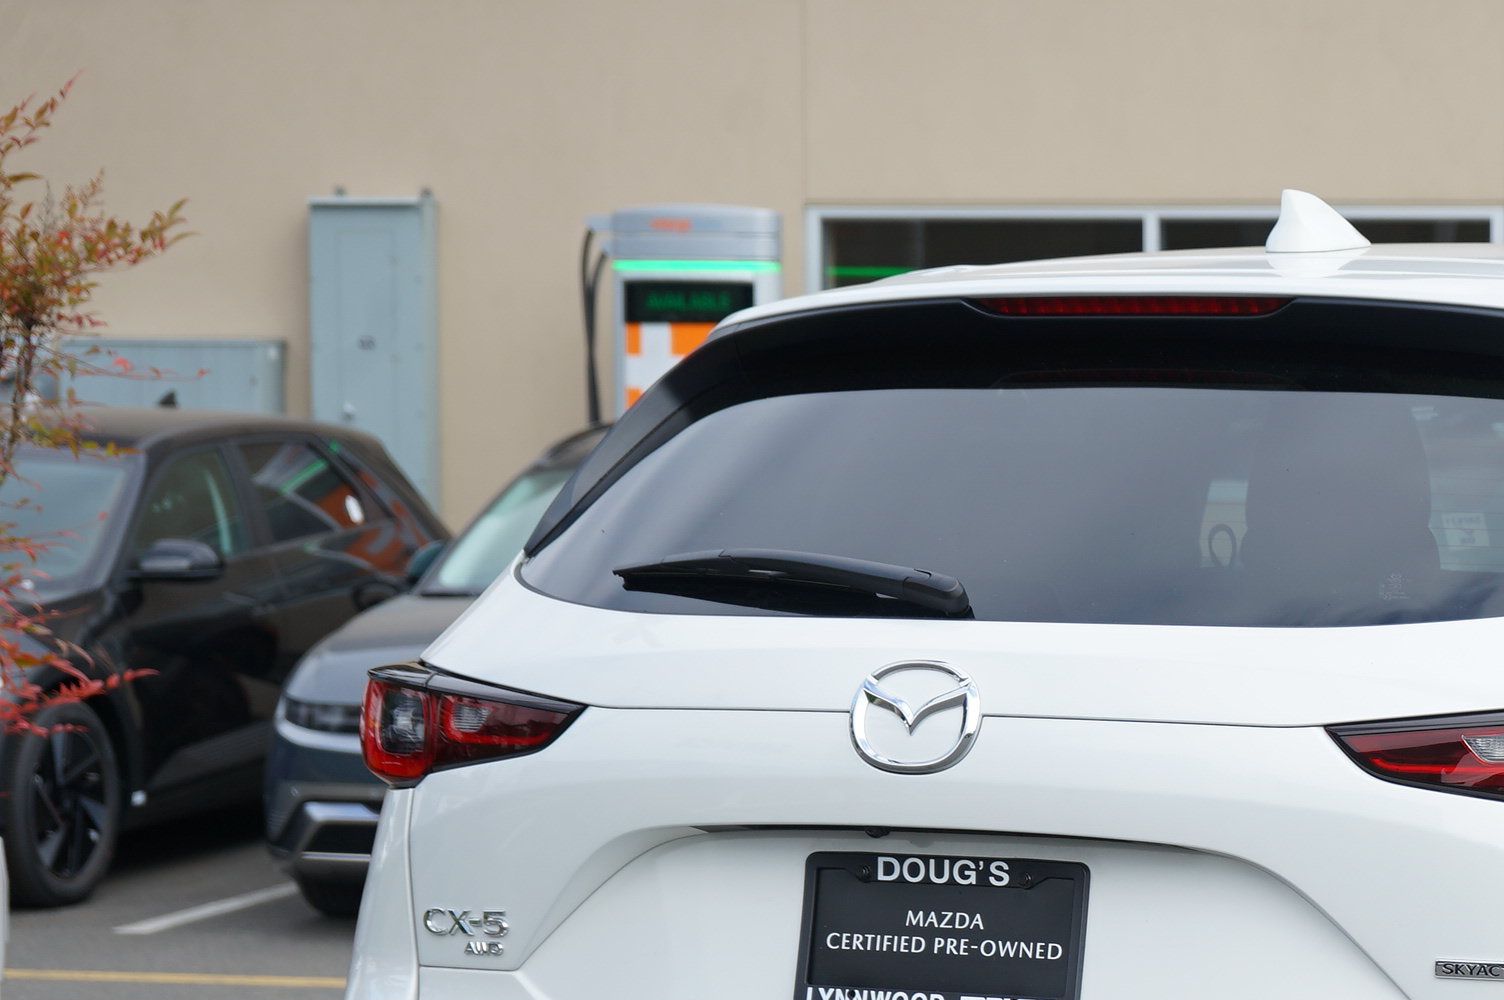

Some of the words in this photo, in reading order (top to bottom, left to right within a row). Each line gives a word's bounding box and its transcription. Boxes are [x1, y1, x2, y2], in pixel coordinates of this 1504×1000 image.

[876, 856, 1010, 887] DOUG'S
[423, 906, 510, 939] CX-5
[905, 909, 985, 931] MAZDA
[463, 940, 505, 957] AWD
[826, 932, 926, 954] CERTIFIED
[933, 937, 1063, 960] PRE-OWNED
